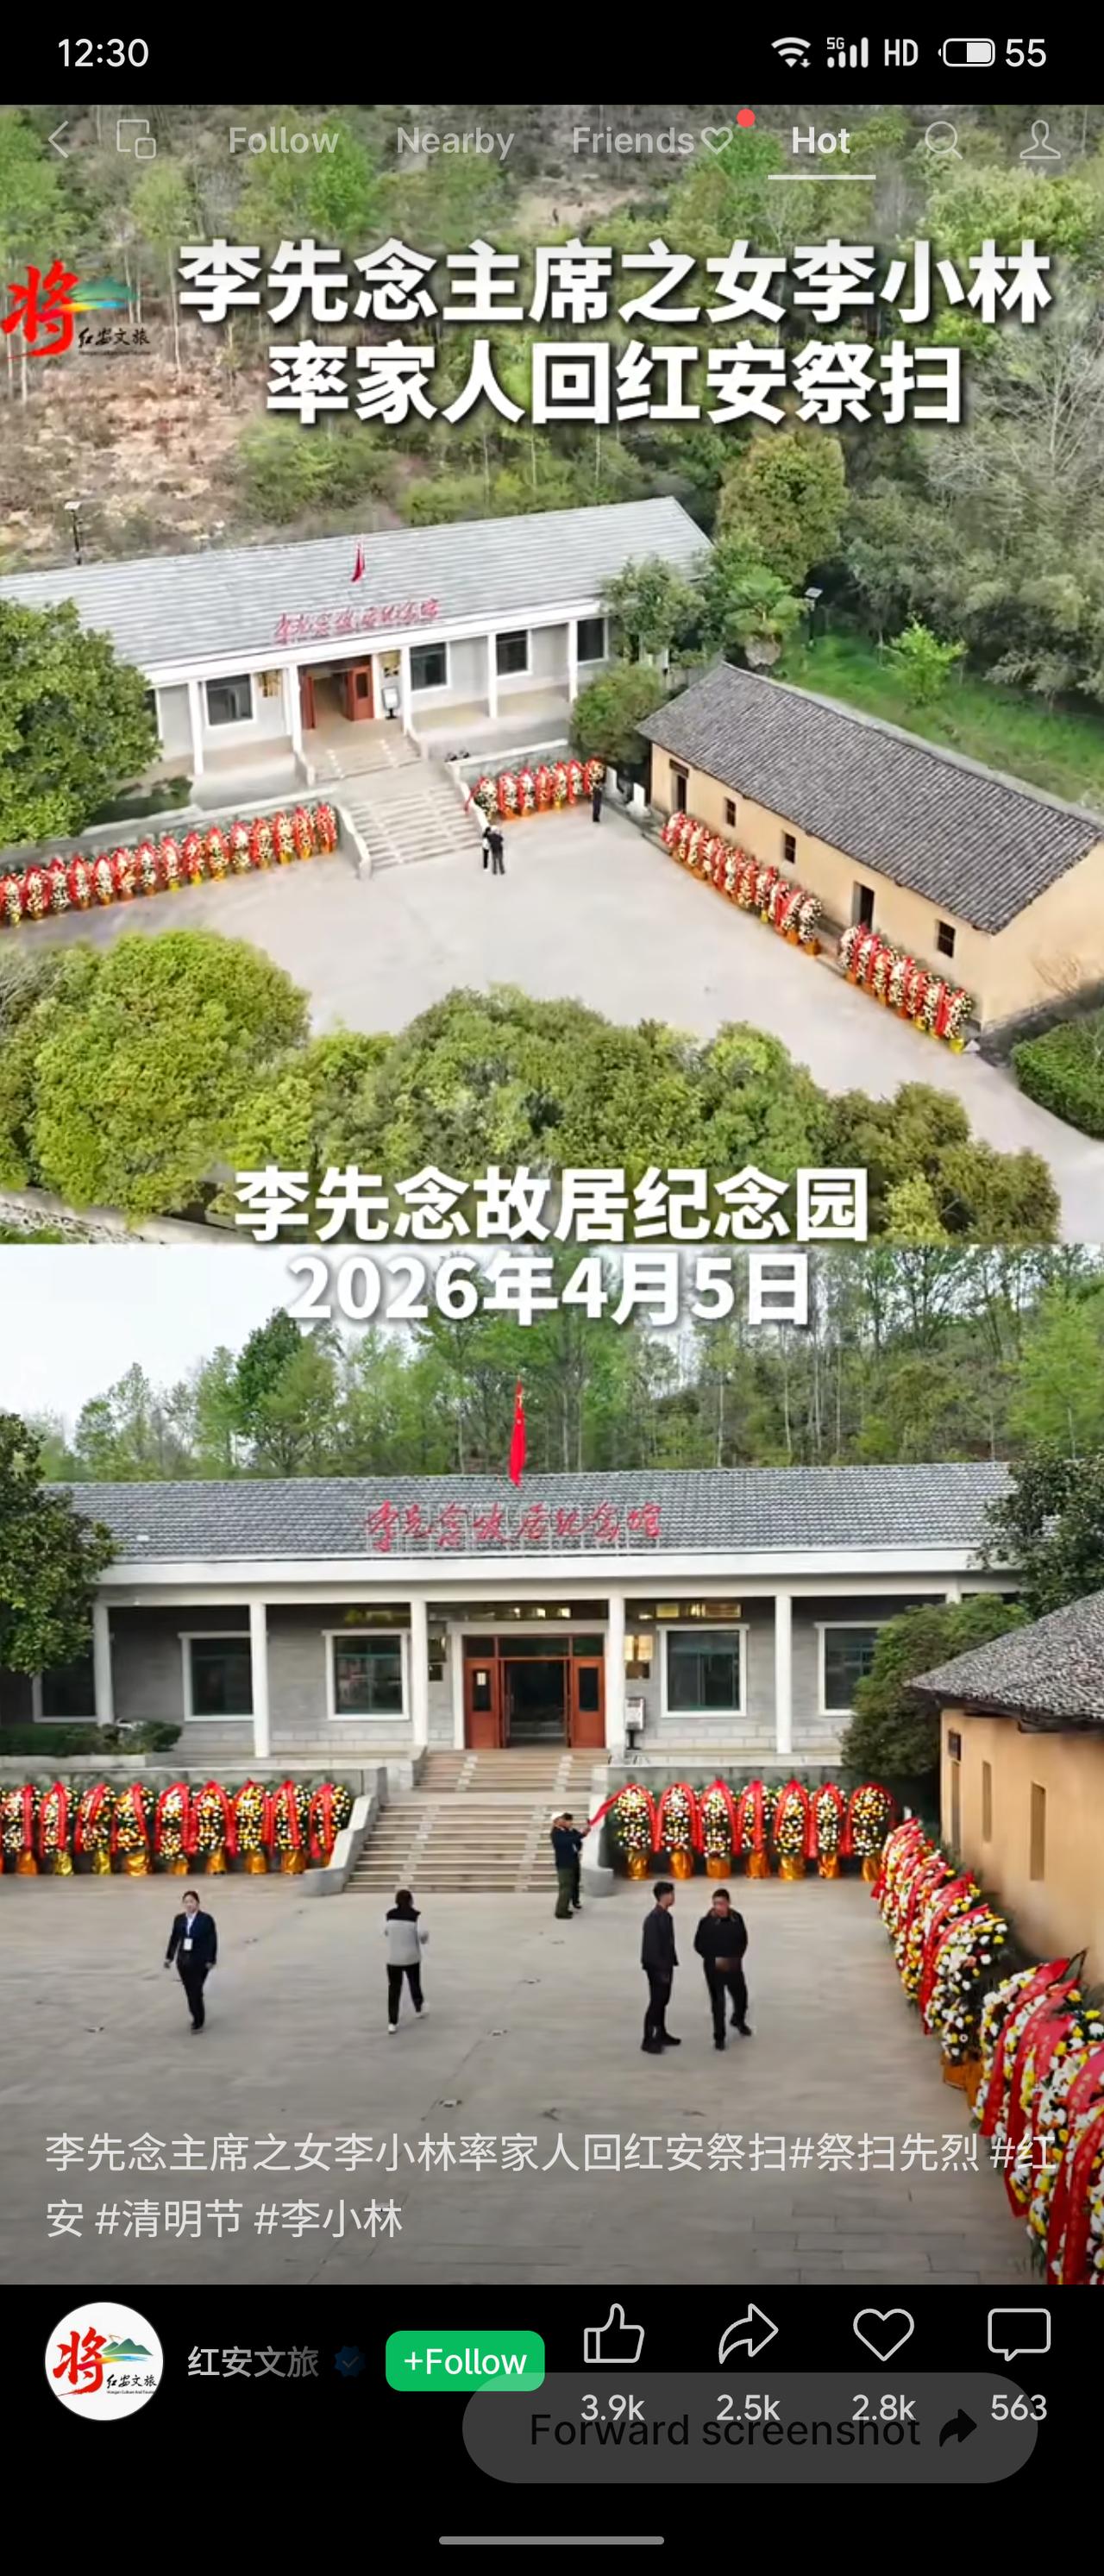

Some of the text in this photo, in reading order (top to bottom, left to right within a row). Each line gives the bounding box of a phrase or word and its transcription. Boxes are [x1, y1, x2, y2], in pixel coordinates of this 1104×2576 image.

[58, 38, 149, 67] 12:30
[826, 37, 845, 49] 5G
[884, 39, 919, 66] HD
[1005, 39, 1047, 67] 55
[229, 127, 339, 154] Follow
[397, 127, 514, 160] Nearby
[572, 126, 695, 154] Friends
[792, 127, 850, 154] Hot
[187, 2345, 320, 2378] 红安文旅
[580, 2393, 645, 2422] 3.9k
[716, 2393, 781, 2422] 2.5k
[851, 2393, 917, 2422] 2.8k
[990, 2394, 1048, 2422] 563
[530, 2414, 922, 2447] Forward screenshot
